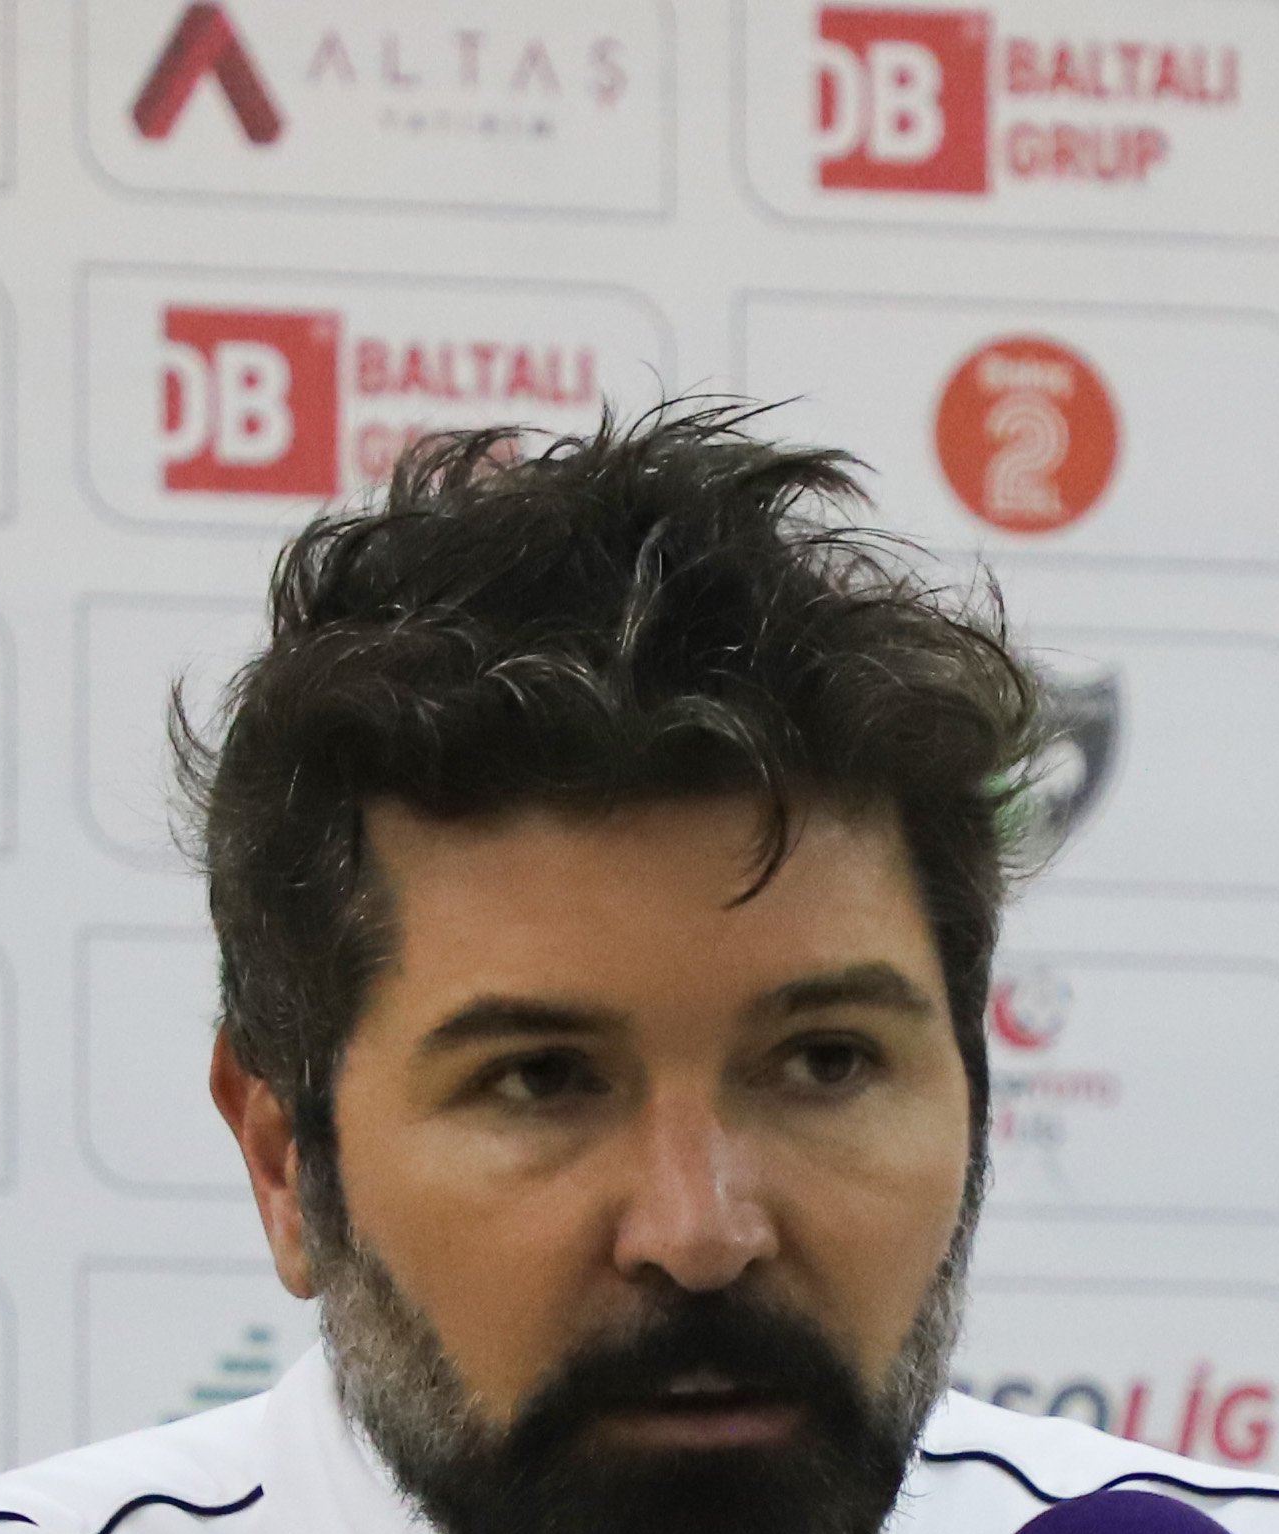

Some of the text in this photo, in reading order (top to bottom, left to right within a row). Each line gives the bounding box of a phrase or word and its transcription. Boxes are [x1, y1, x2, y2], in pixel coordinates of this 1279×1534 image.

[1007, 38, 1239, 106] BALTALI
[1007, 121, 1169, 185] GRUP
[356, 338, 596, 408] BALTALI
